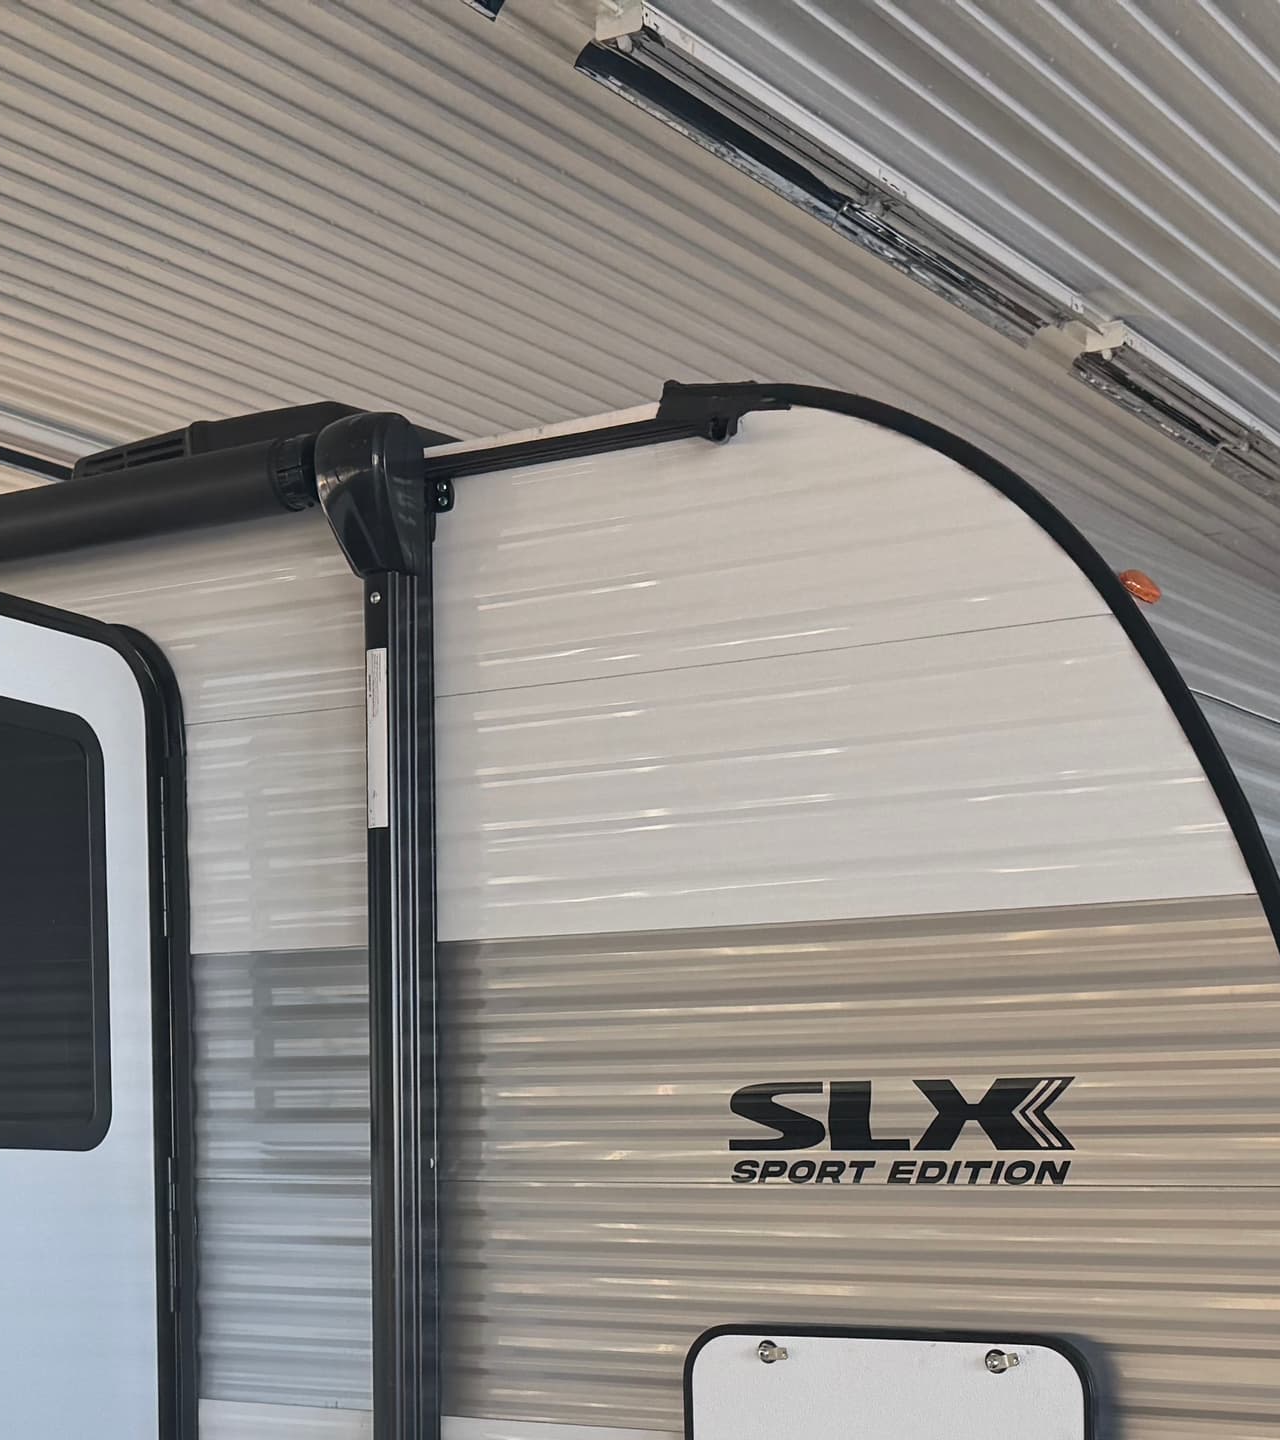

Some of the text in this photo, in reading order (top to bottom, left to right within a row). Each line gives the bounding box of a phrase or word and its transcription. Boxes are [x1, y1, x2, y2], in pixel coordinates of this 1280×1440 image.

[728, 1076, 1076, 1151] SLX
[731, 1159, 1072, 1185] SPORT EDITION
